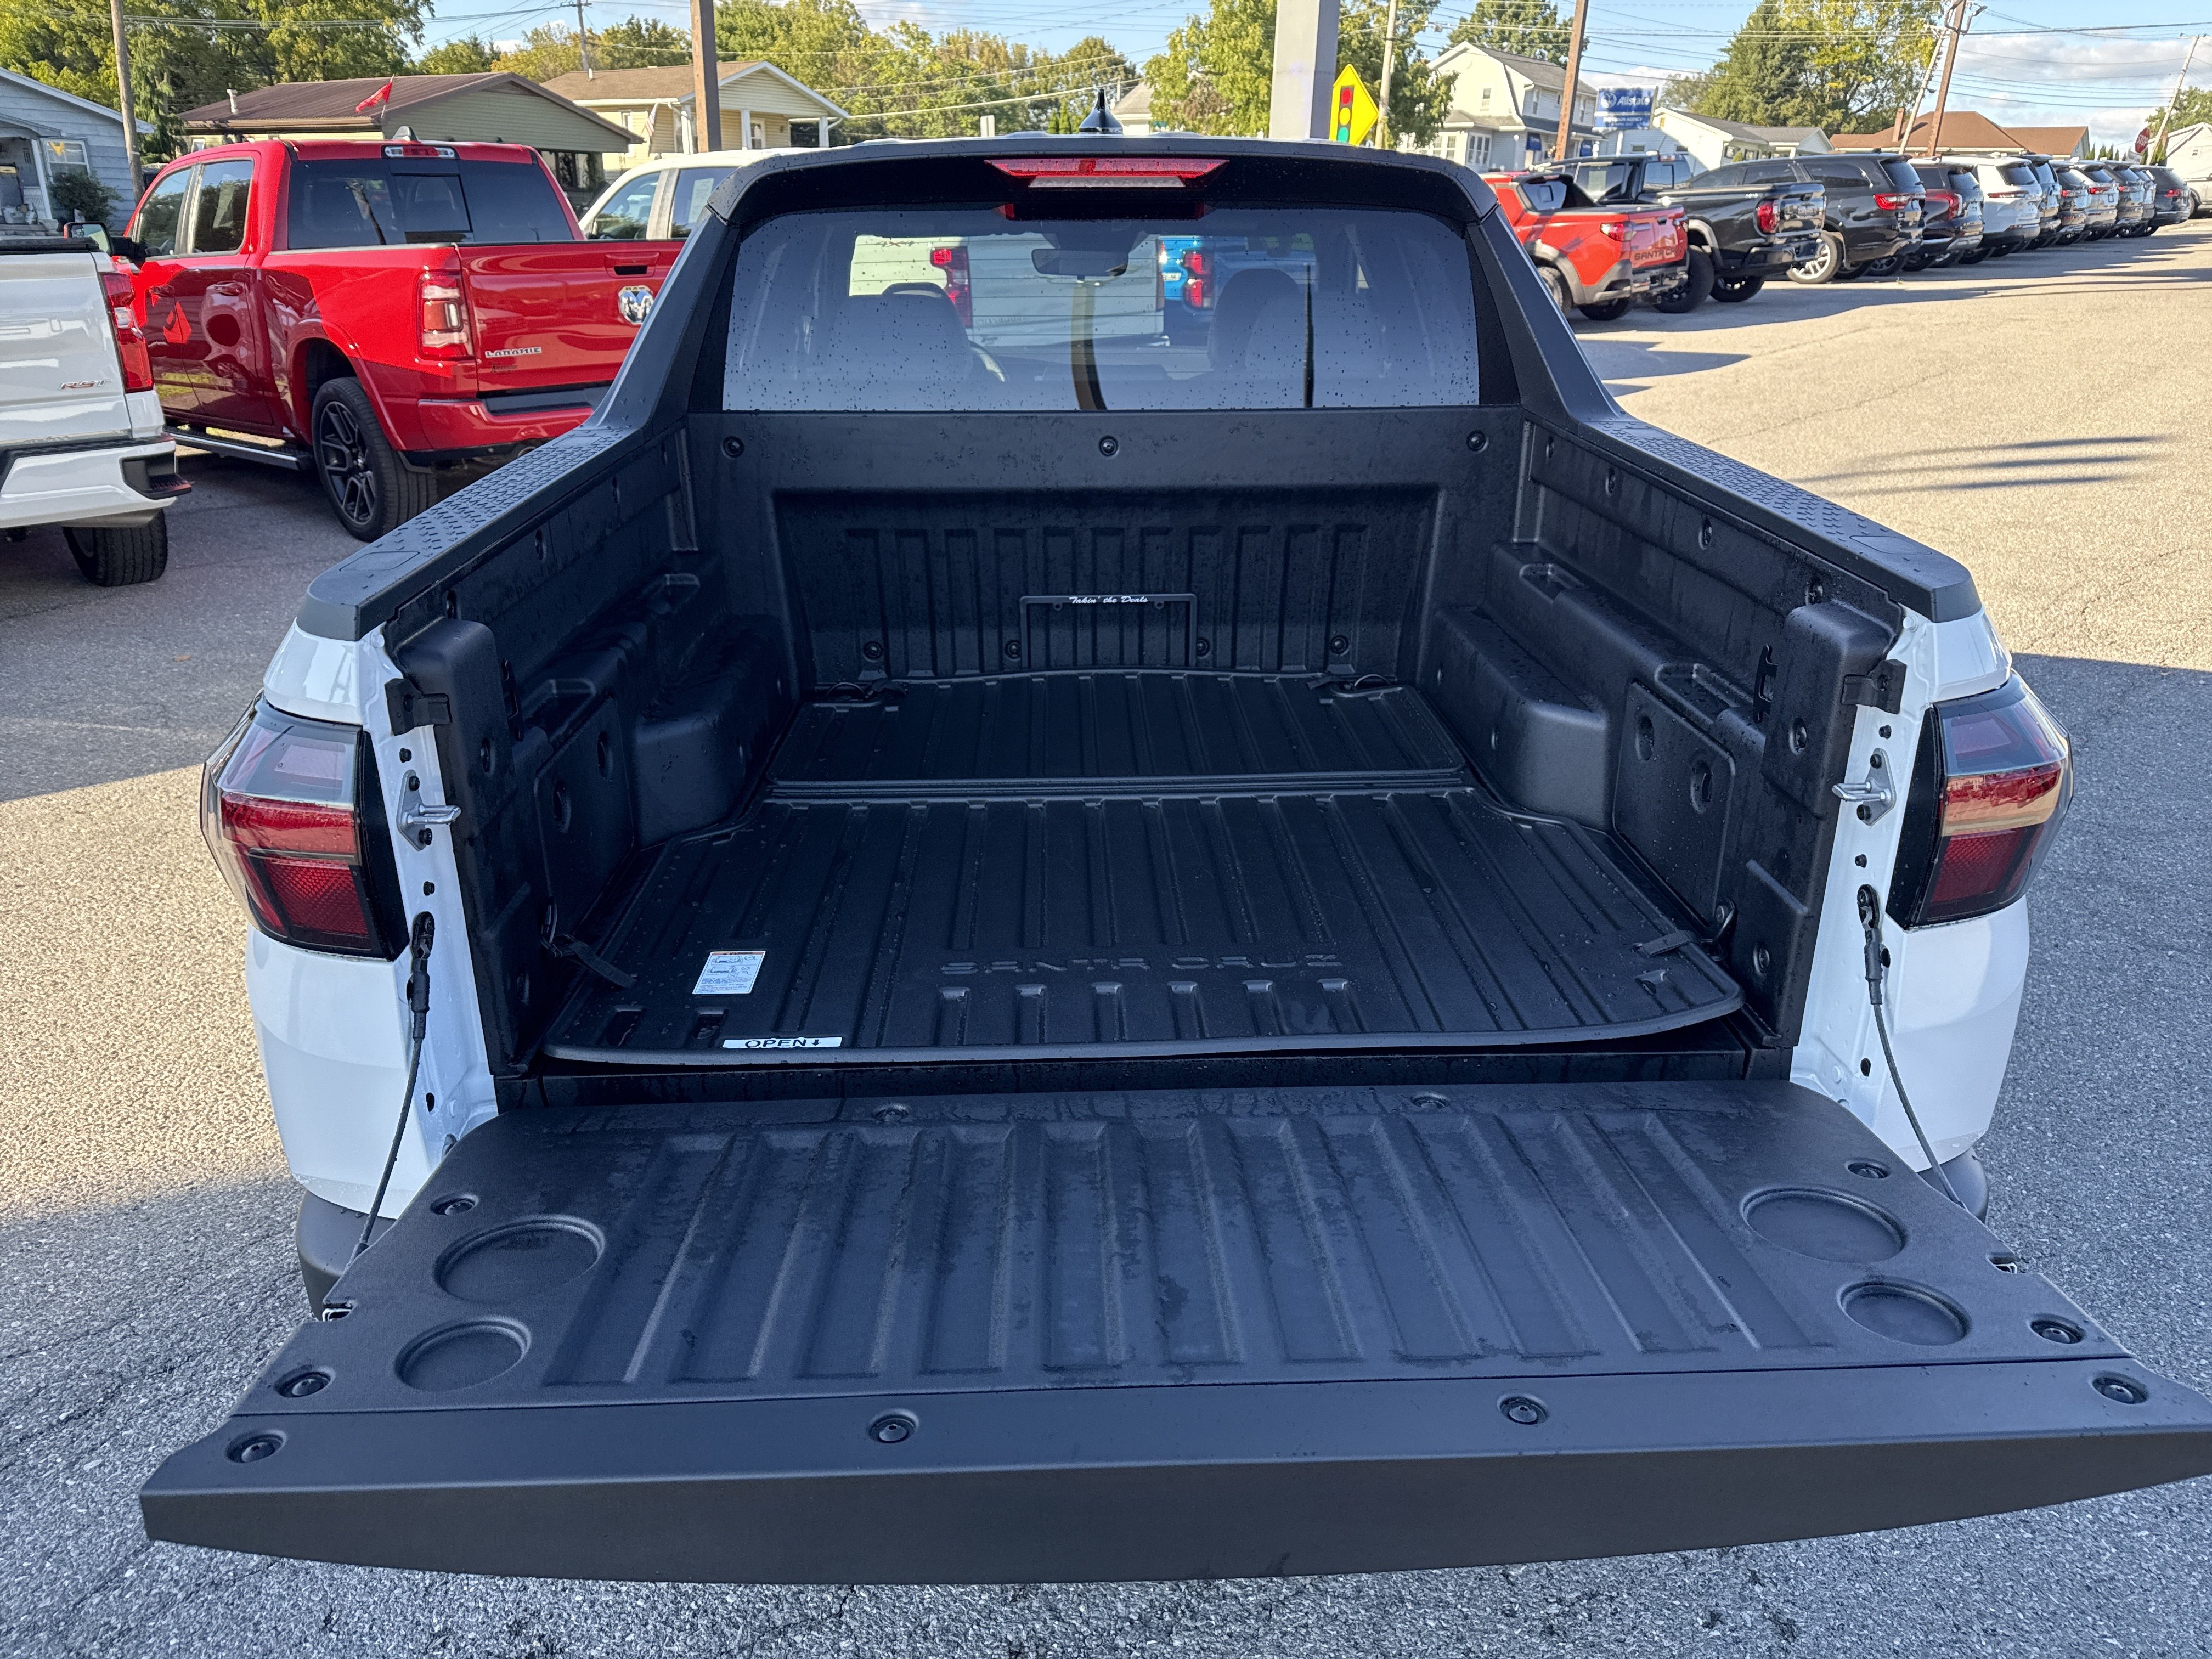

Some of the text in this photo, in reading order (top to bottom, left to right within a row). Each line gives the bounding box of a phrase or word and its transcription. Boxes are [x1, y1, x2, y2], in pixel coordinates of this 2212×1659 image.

[1616, 95, 1650, 106] Allstate
[2137, 134, 2149, 147] STOP
[1634, 249, 1664, 261] SANTA
[485, 347, 542, 358] LARAMIE
[57, 379, 113, 390] RST
[940, 953, 1343, 974] SANTA CRUZ
[745, 1039, 807, 1048] OPEN
